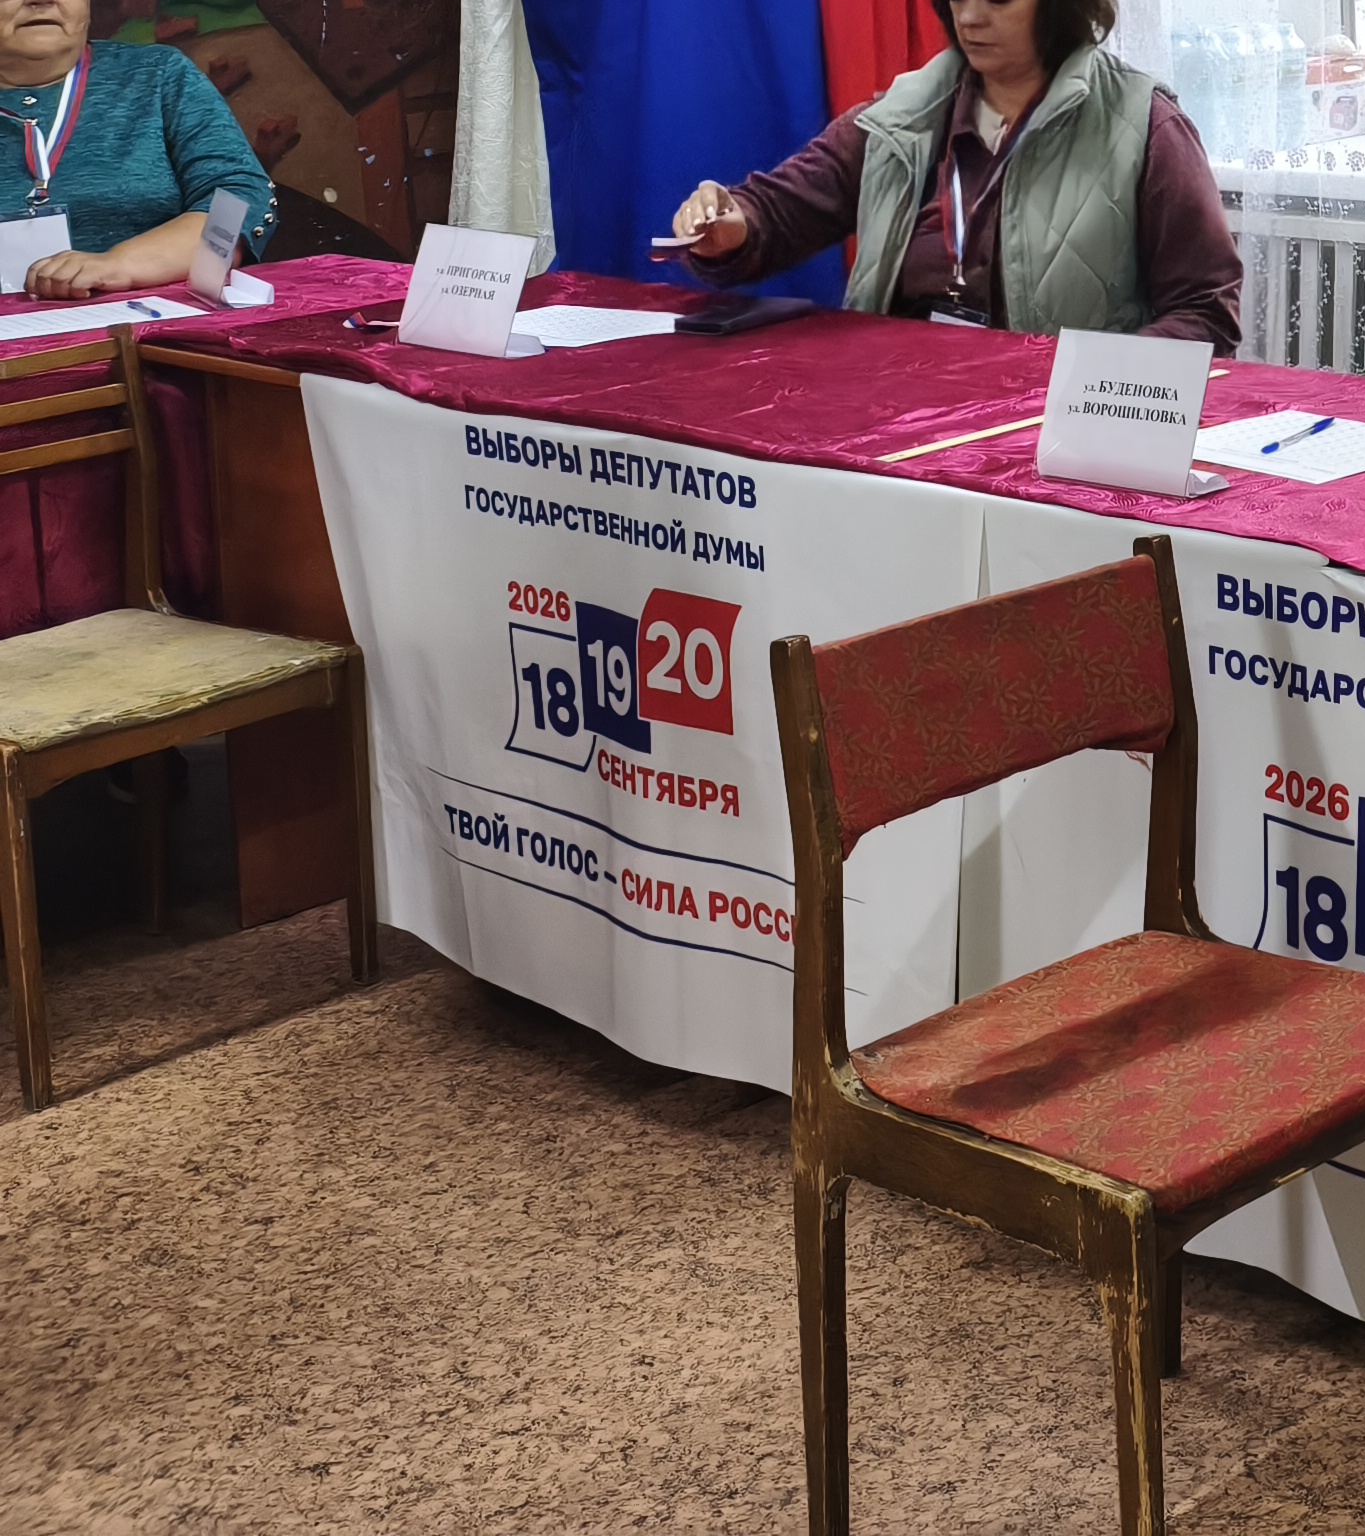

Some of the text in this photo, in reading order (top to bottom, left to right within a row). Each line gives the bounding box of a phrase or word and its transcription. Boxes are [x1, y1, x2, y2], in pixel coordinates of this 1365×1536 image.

[446, 265, 511, 284] ПРИГОРСКАЯ
[451, 284, 495, 300] ОЗЕРНАЯ
[1083, 401, 1186, 425] ВОРОШИЛОВКА
[1099, 380, 1178, 402] БУДЕНОВКА
[464, 424, 757, 509] ВЫБОРЫ ДЕПУТАТОВ
[464, 484, 765, 573] ГОСУДАРСТВЕННОЙ ДУМЫ
[507, 580, 571, 622] 2026
[521, 620, 724, 737] 18 19 20
[597, 749, 740, 818] СЕНТЯБРЯ
[1264, 764, 1350, 821] 2026
[443, 803, 510, 853] ТВОЙ
[517, 826, 599, 883] ГОЛОС
[621, 868, 699, 919] СИЛА
[1276, 865, 1348, 962] 18
